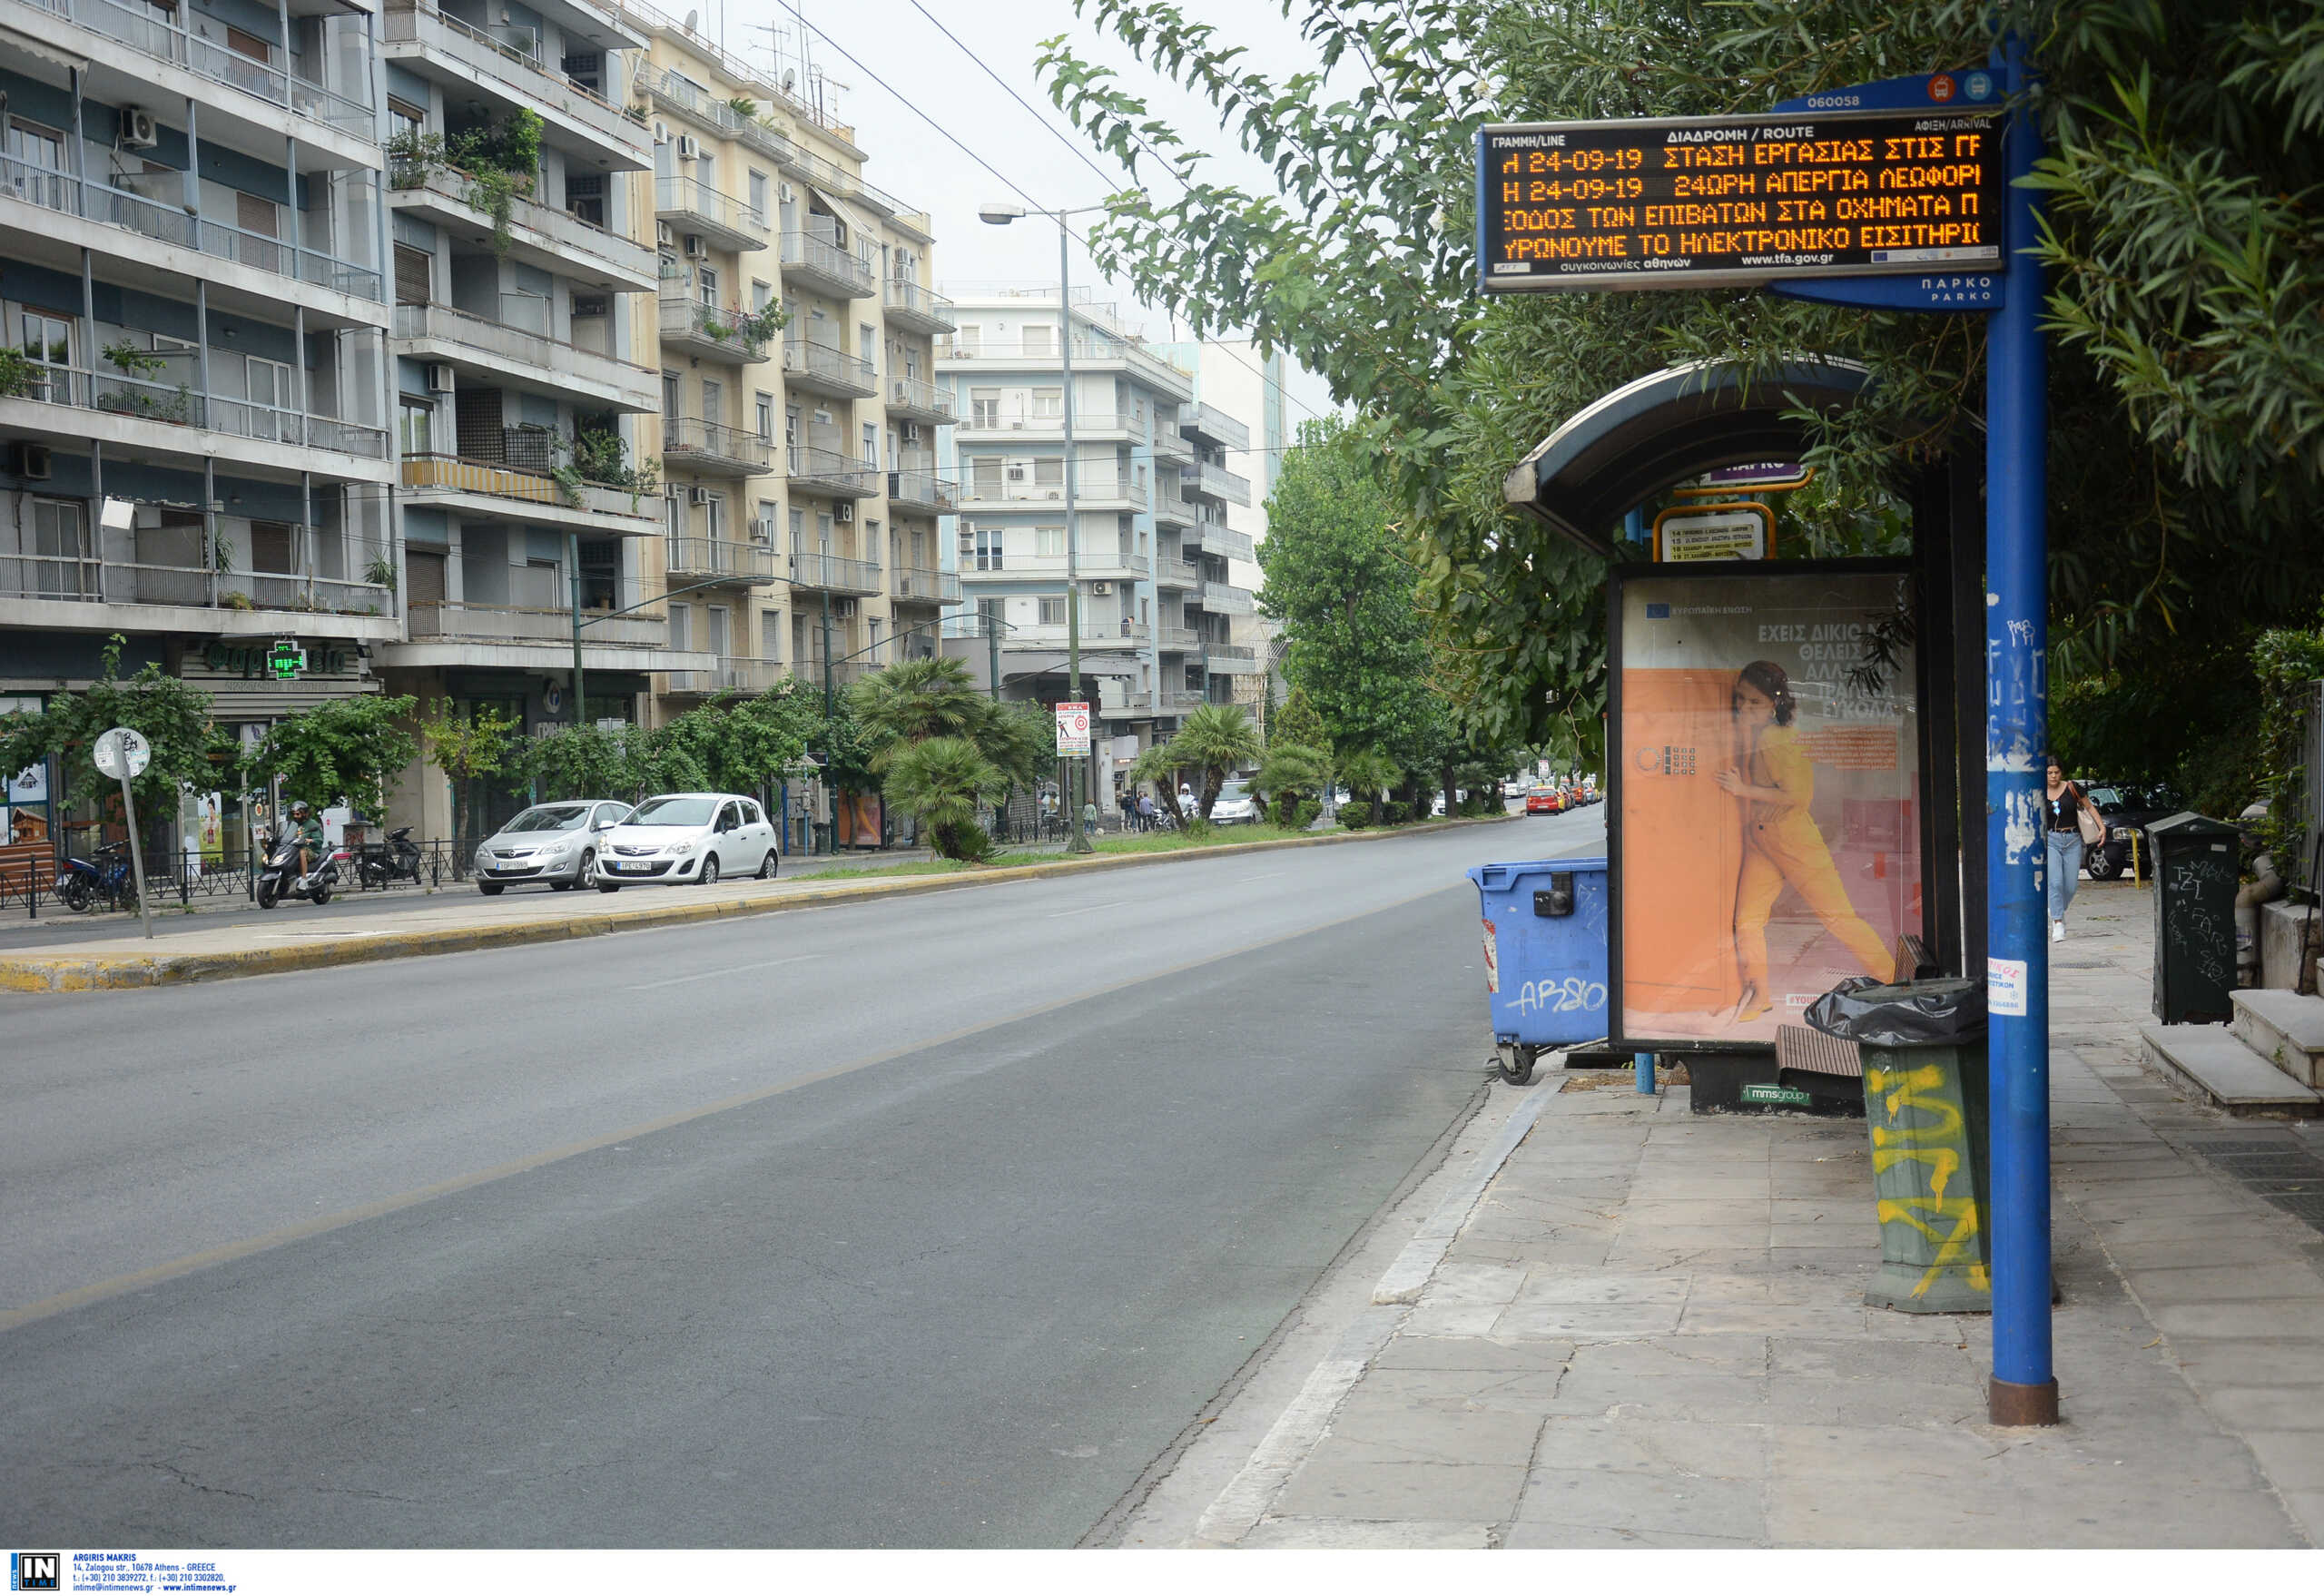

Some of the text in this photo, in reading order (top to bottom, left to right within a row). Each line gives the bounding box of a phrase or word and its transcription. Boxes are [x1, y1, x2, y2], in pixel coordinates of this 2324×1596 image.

[1807, 95, 1859, 108] 060058
[1492, 135, 1565, 148] ΓΡΑΜΜΗ/LINE
[1667, 128, 1748, 143] ΔΙΑΔΡΟΜΗ
[1764, 126, 1814, 139] ROUTE
[1530, 149, 1642, 172] 24-09-19
[1664, 144, 1744, 168] ΣΤΑΣΗ
[1755, 140, 1873, 164] ΕΡΓΑΣΙΑΣ
[1886, 137, 1945, 160] ΣΤΙΣ
[1530, 177, 1642, 202] 24-09-19
[1675, 173, 1756, 197] 24ΩΡΗ
[1767, 170, 1868, 192] ΑΠΕΡΓΙΑ
[1588, 206, 1634, 228] ΤΩΝ
[1646, 202, 1766, 226] ΕΠΙΒΑΤΩΝ
[1777, 200, 1826, 222] ΣΤΑ
[1837, 194, 1950, 219] ΟΧΗΜΑΤΑ
[1638, 233, 1670, 255] ΤΟ
[1680, 227, 1850, 254] ΗΛΕΚΤΡΟΝΙΚΟ
[1561, 257, 1691, 272] συγκοινωνίες αθηνών
[1741, 252, 1834, 265] www.tfa.gov.gr
[1922, 277, 1991, 289] ΠΑΡΚΟ
[1931, 292, 1991, 301] PARKO
[1758, 625, 1806, 643] ΕΧΕΙΣ
[1798, 643, 1861, 661] ΘΕΛΕΙΣ
